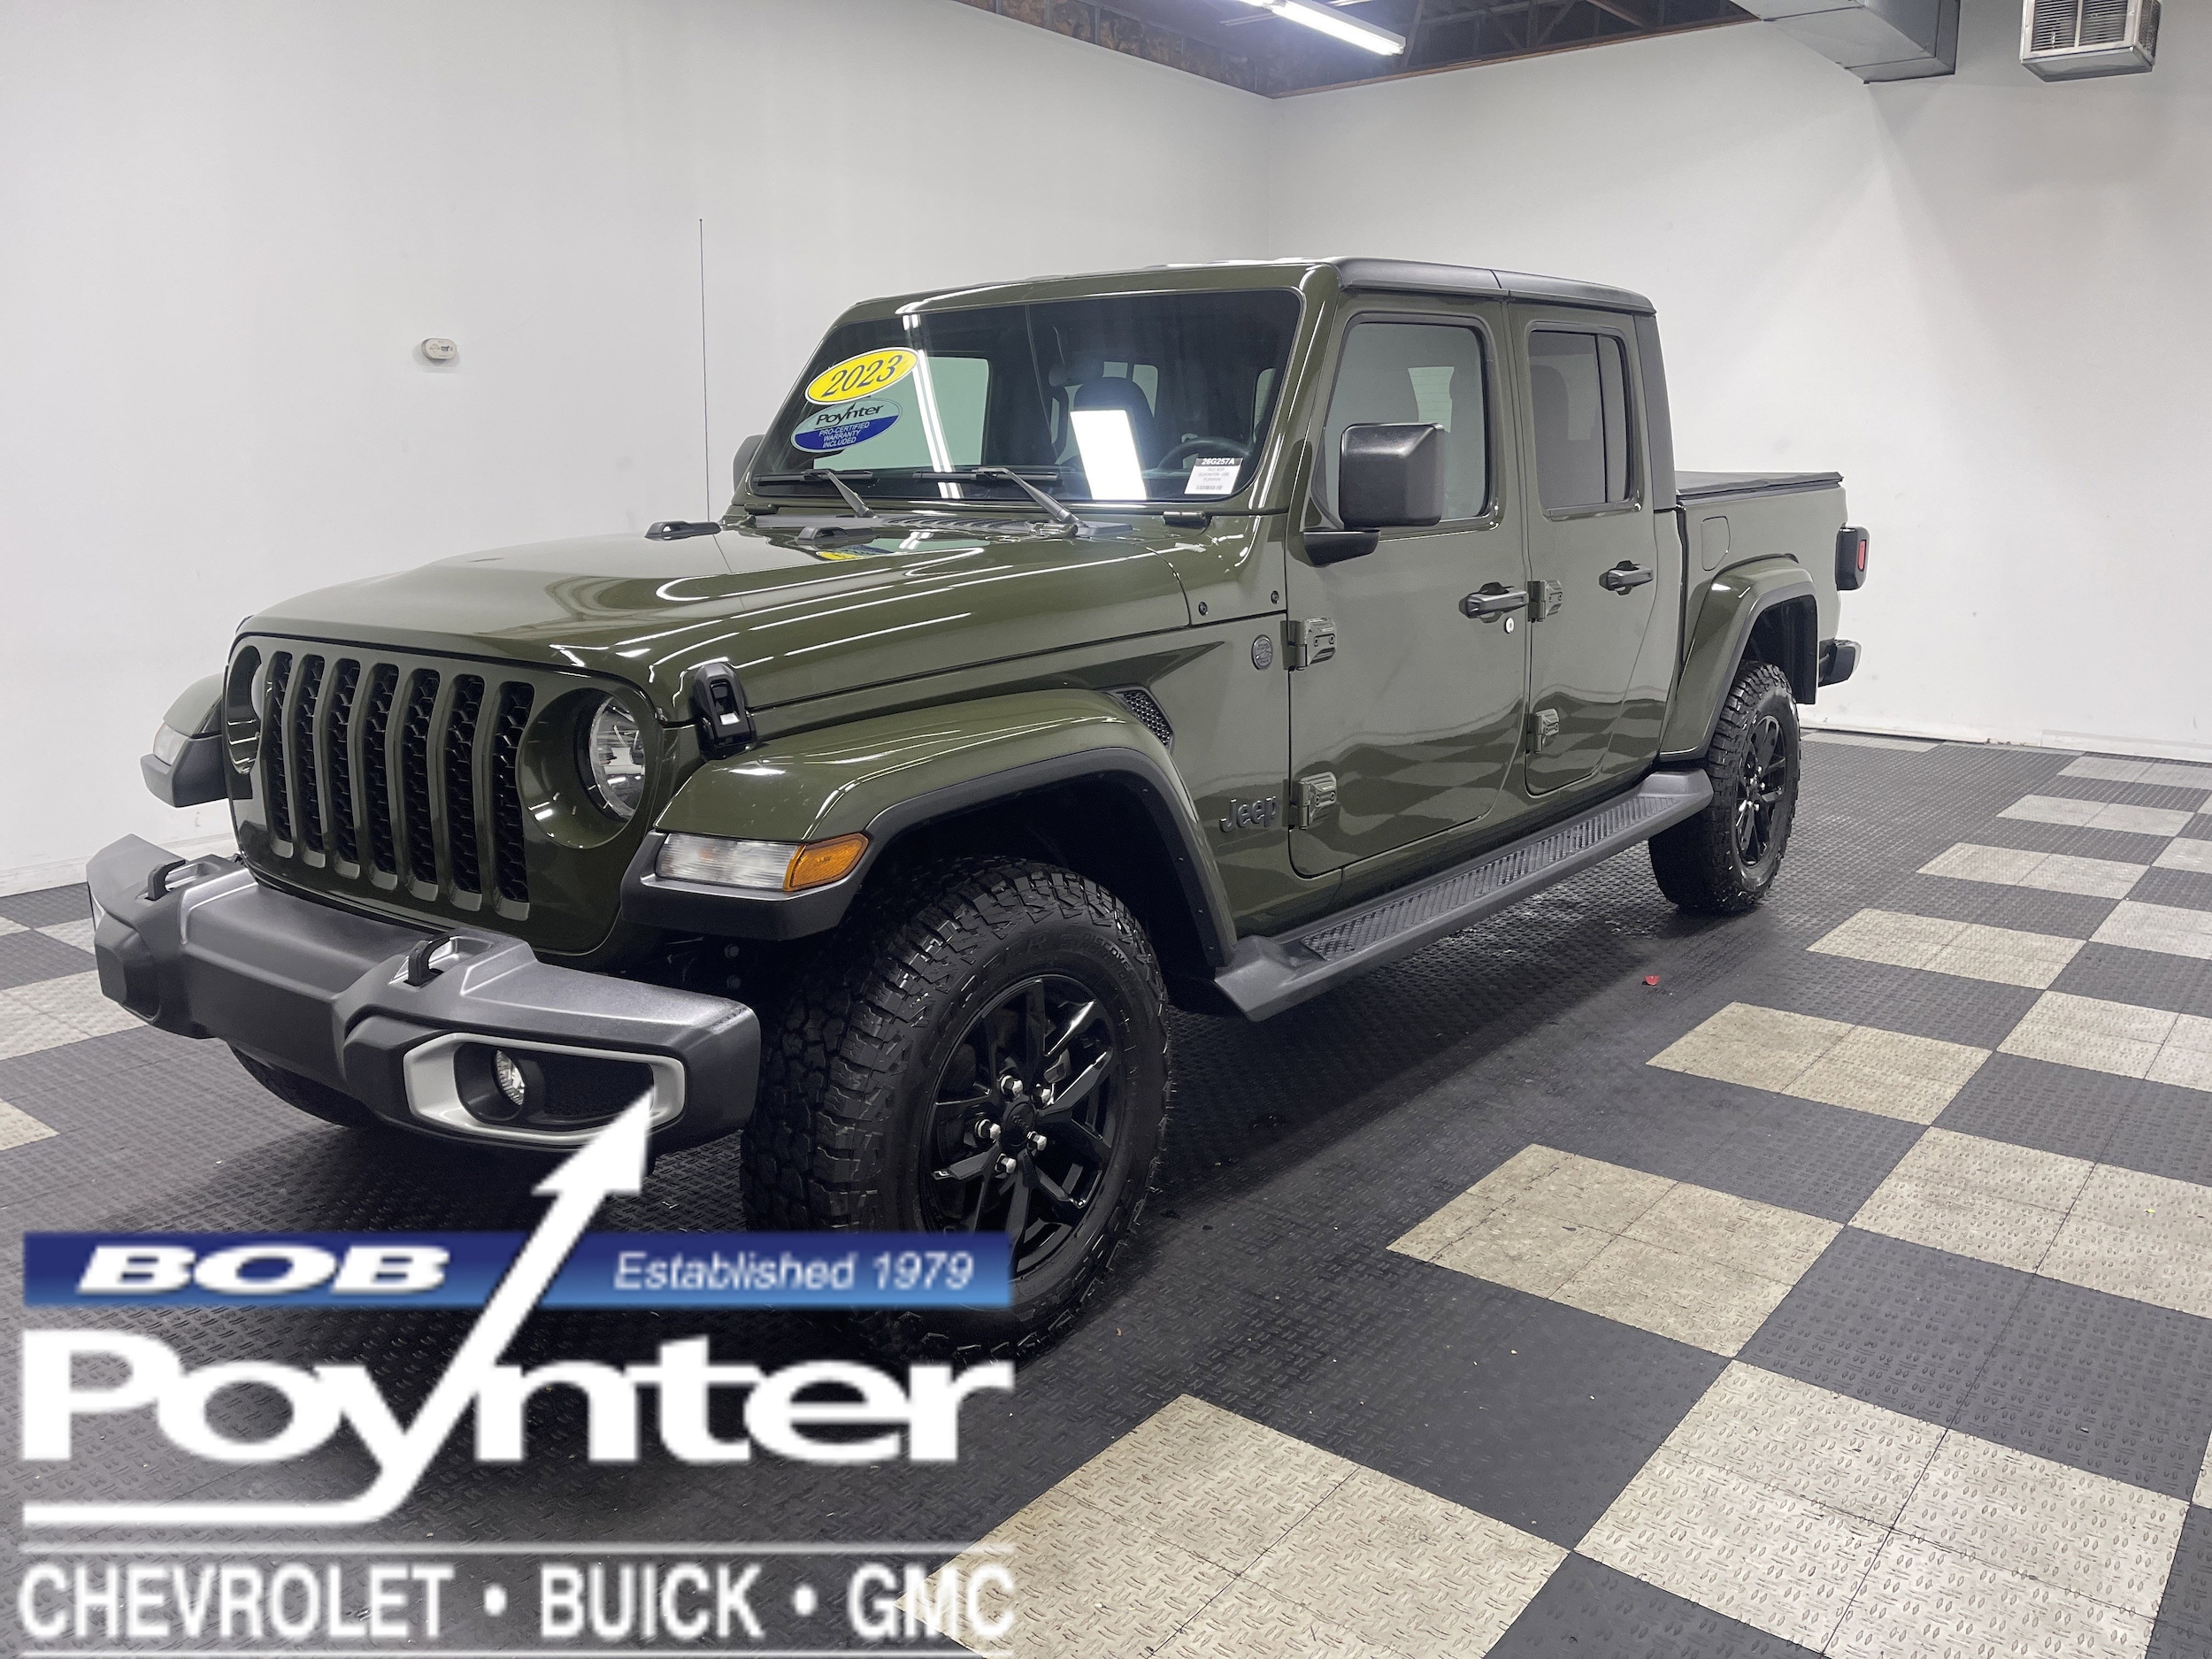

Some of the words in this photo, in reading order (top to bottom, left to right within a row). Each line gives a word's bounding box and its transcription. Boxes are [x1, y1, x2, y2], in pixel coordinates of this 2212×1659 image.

[821, 355, 902, 397] 2023
[816, 403, 884, 426] Poynter
[818, 421, 871, 436] PRO-CERTIFIED
[824, 429, 862, 442] WARRANTY
[822, 436, 856, 449] INCLUDED
[1219, 796, 1277, 833] Jeep
